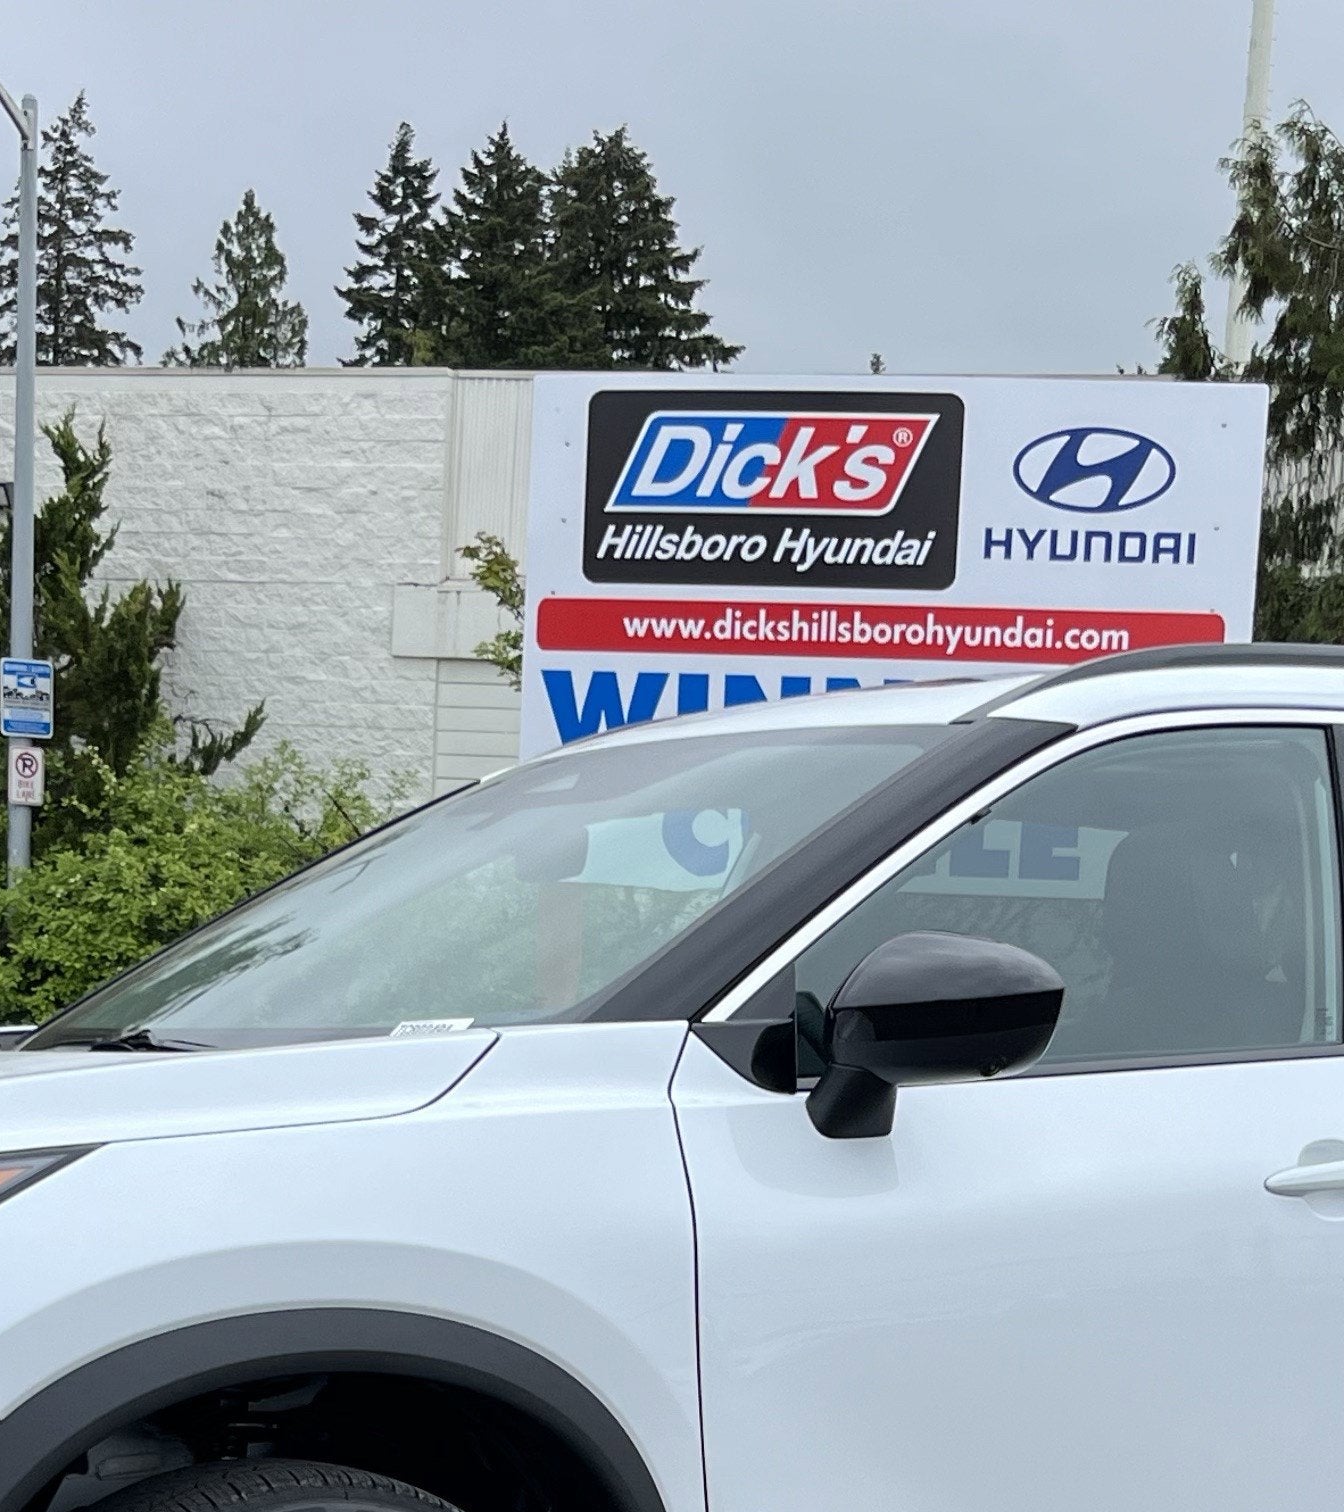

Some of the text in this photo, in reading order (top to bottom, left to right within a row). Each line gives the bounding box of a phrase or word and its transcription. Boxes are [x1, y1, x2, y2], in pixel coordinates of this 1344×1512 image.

[631, 424, 897, 502] Dick's
[596, 524, 937, 573] Hillsboro Hyundai
[983, 527, 1198, 567] HYUNDAI
[623, 608, 1131, 656] www.dickshillsborohyundai.com
